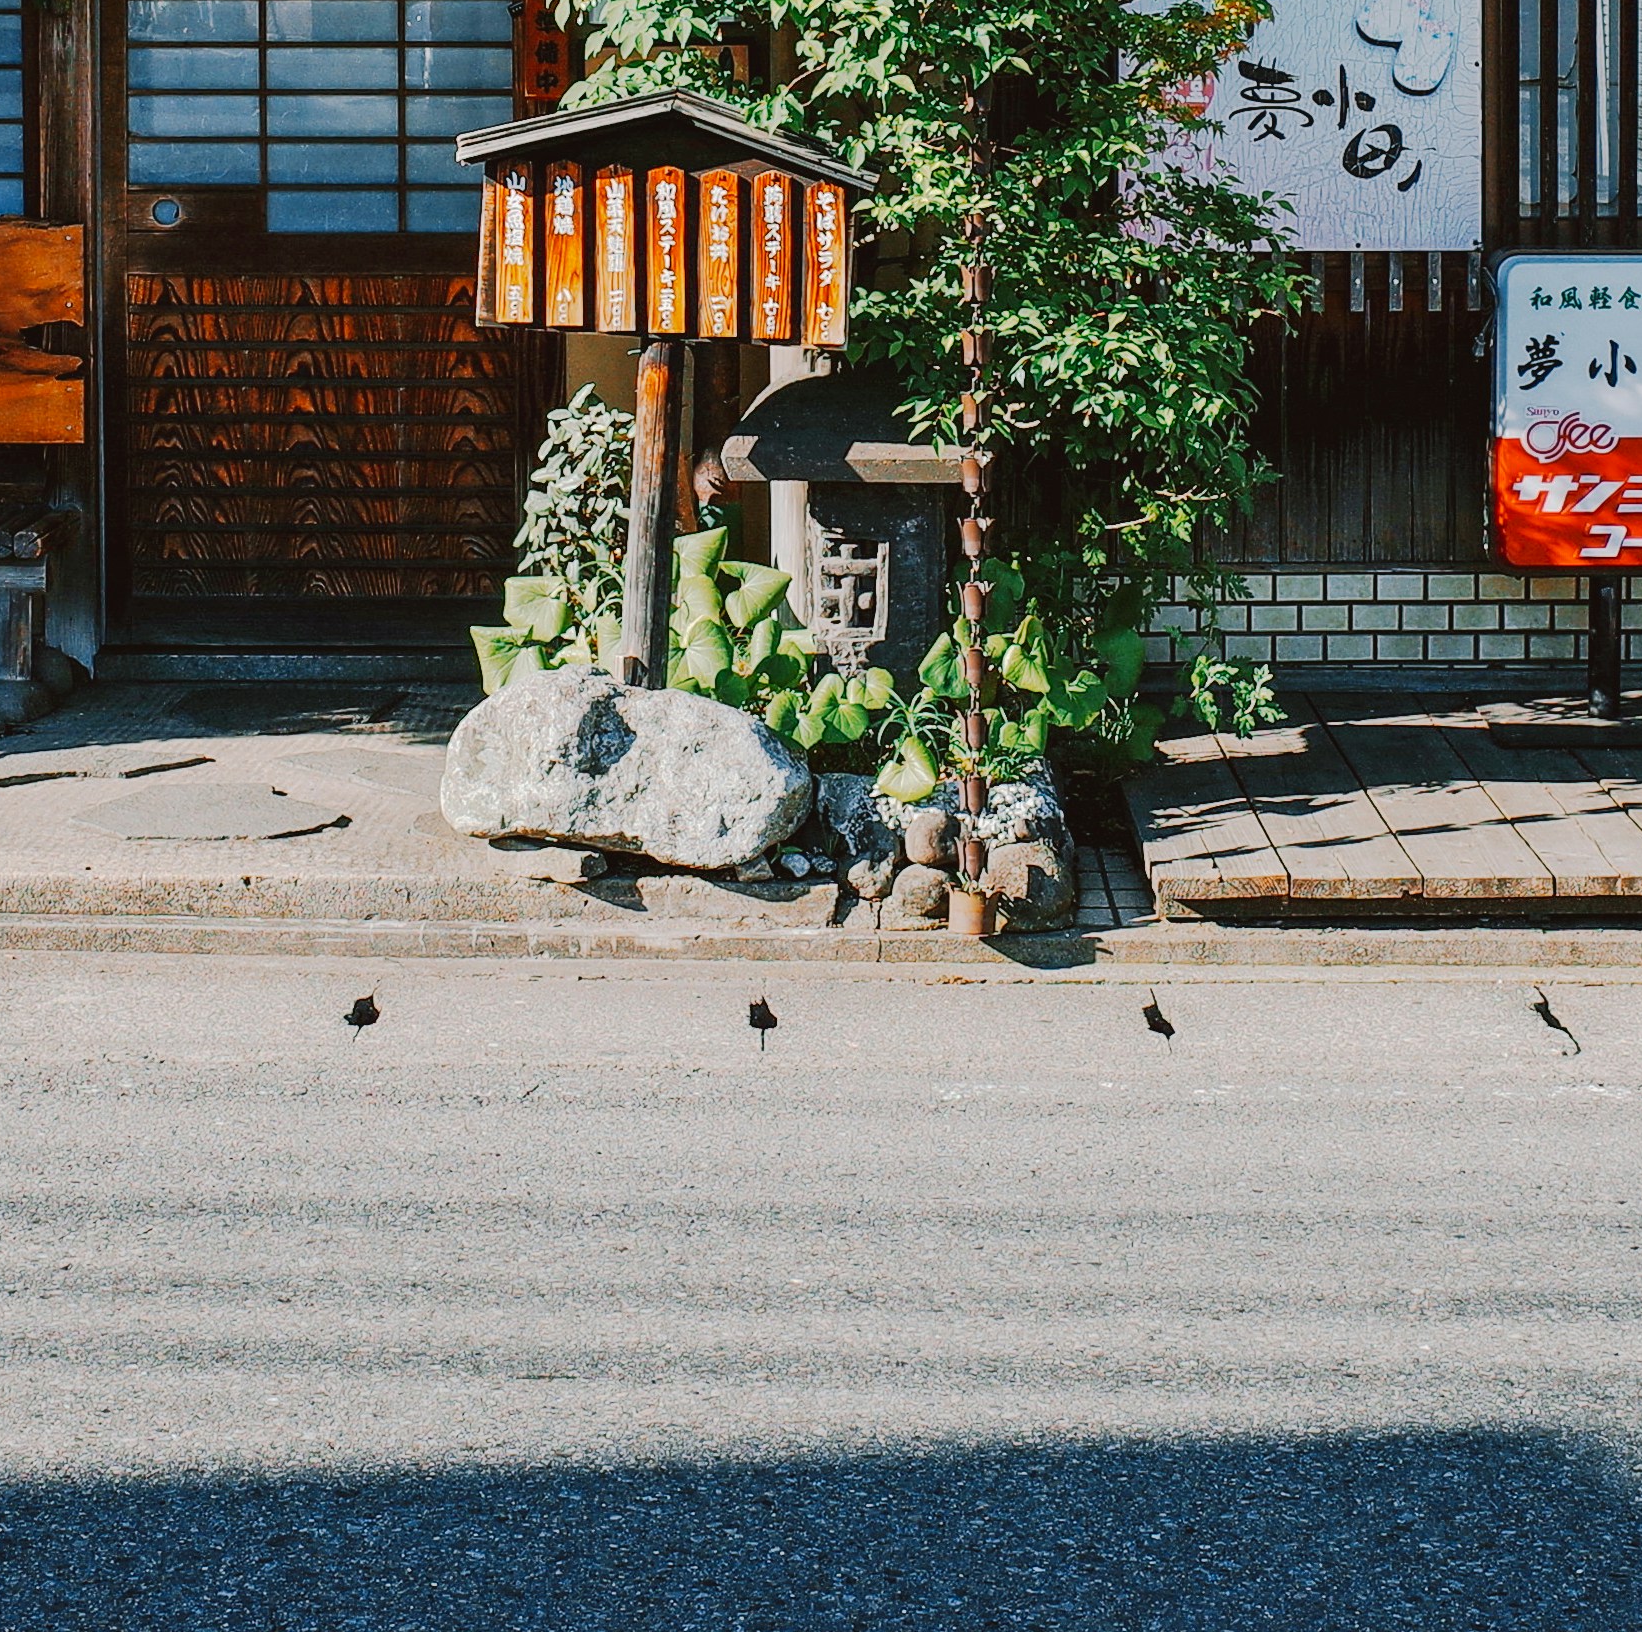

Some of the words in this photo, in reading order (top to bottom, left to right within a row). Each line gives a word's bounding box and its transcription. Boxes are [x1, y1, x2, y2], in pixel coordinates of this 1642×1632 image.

[709, 185, 730, 263] たけお丼
[816, 191, 838, 288] そばサラダ
[1526, 406, 1560, 418] Sanyo
